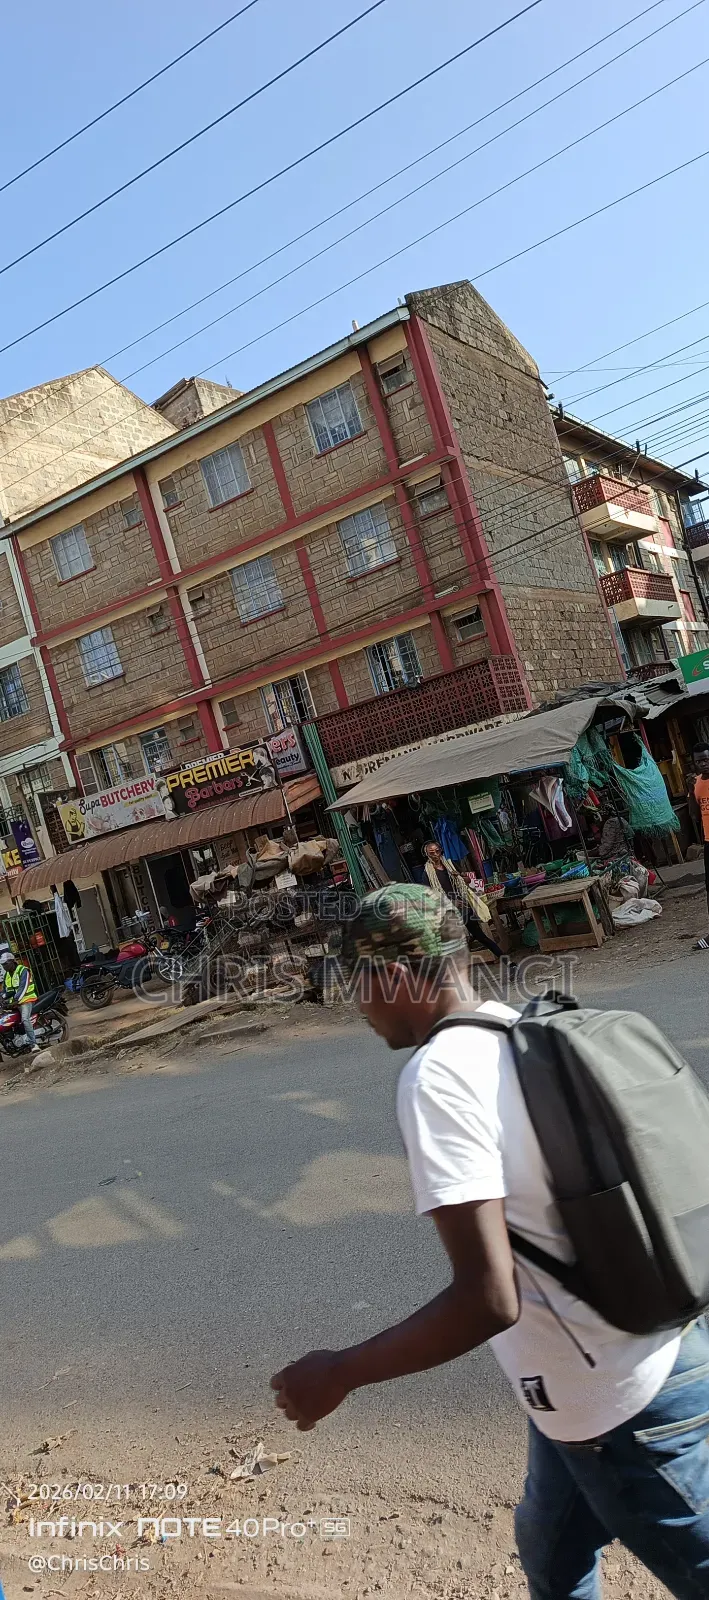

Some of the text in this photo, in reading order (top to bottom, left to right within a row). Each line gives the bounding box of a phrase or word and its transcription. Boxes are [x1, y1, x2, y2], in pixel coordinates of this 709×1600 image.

[166, 749, 256, 793] PREMIER
[78, 778, 156, 815] Supa BUTCHERY
